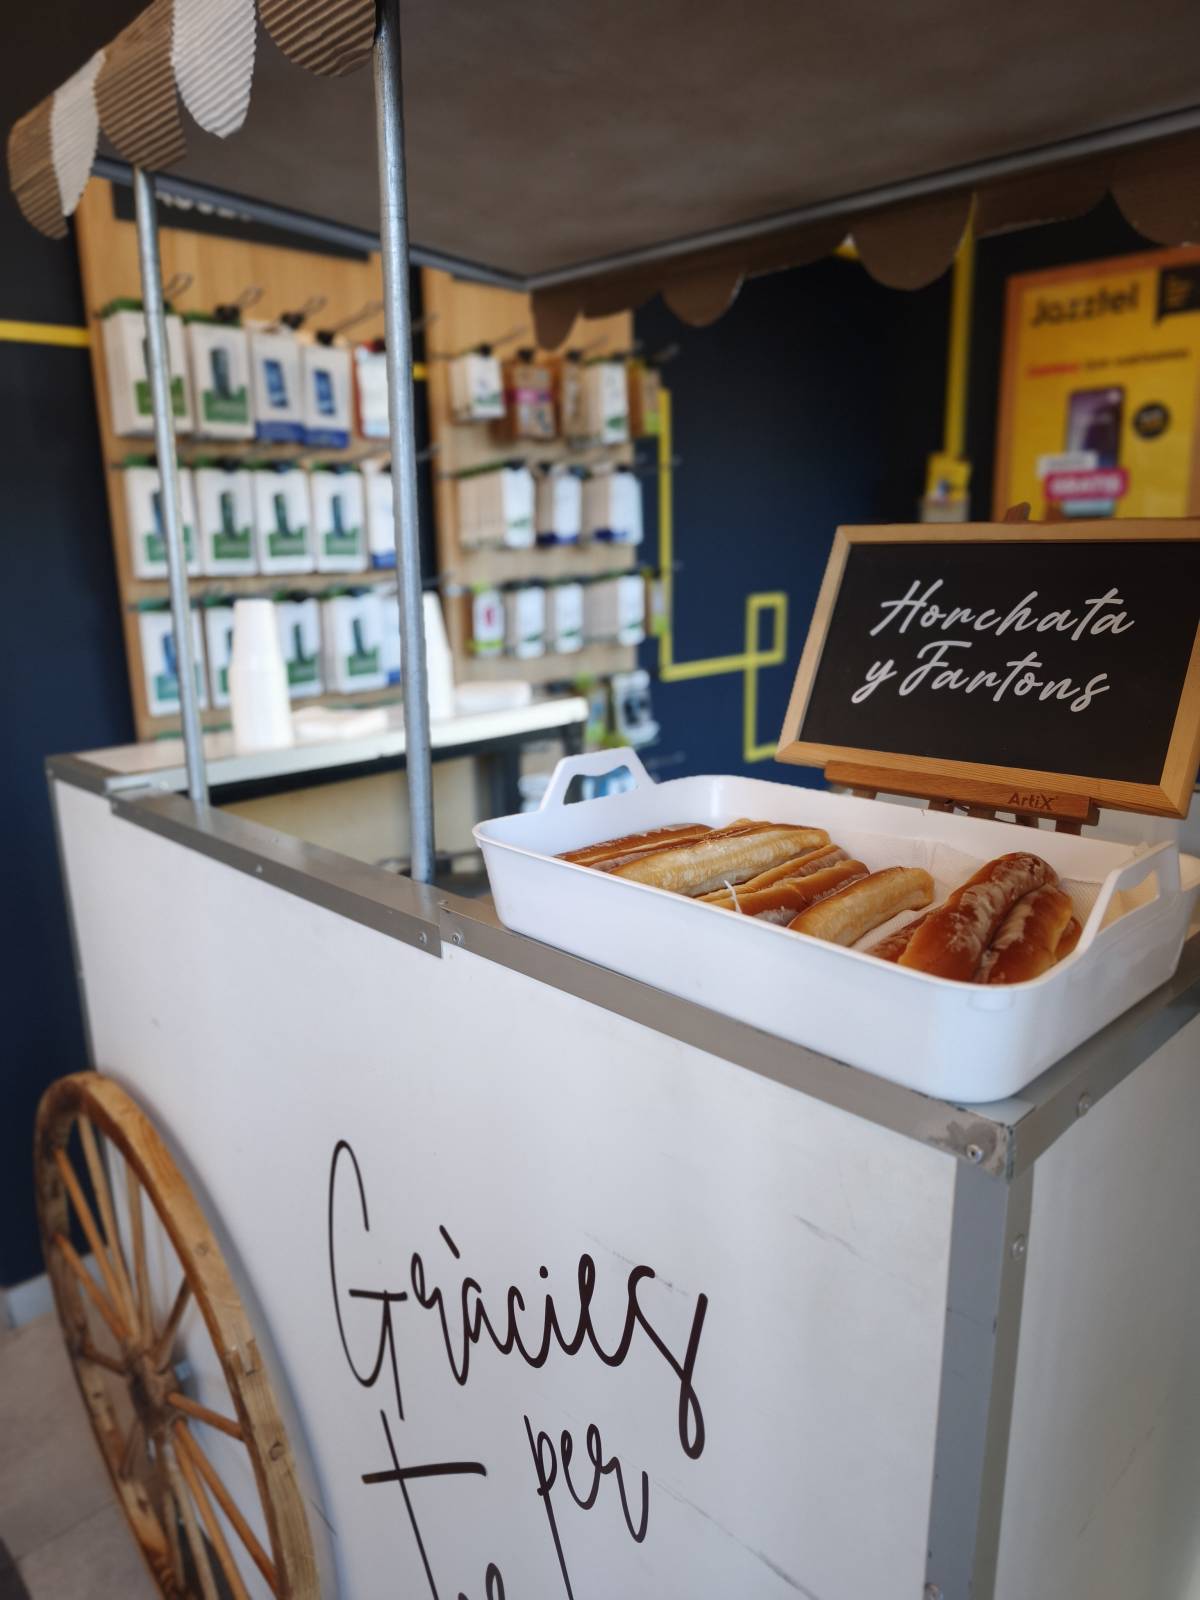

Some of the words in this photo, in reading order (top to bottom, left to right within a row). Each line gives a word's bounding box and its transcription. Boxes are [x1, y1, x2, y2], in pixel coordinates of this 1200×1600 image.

[1031, 282, 1141, 327] Jazztel
[869, 578, 1135, 641] Horchata
[851, 657, 897, 704] y
[898, 639, 1111, 713] Fartons
[1007, 791, 1055, 811] ArtiX
[328, 1139, 709, 1460] Gràcies
[523, 1414, 649, 1600] per
